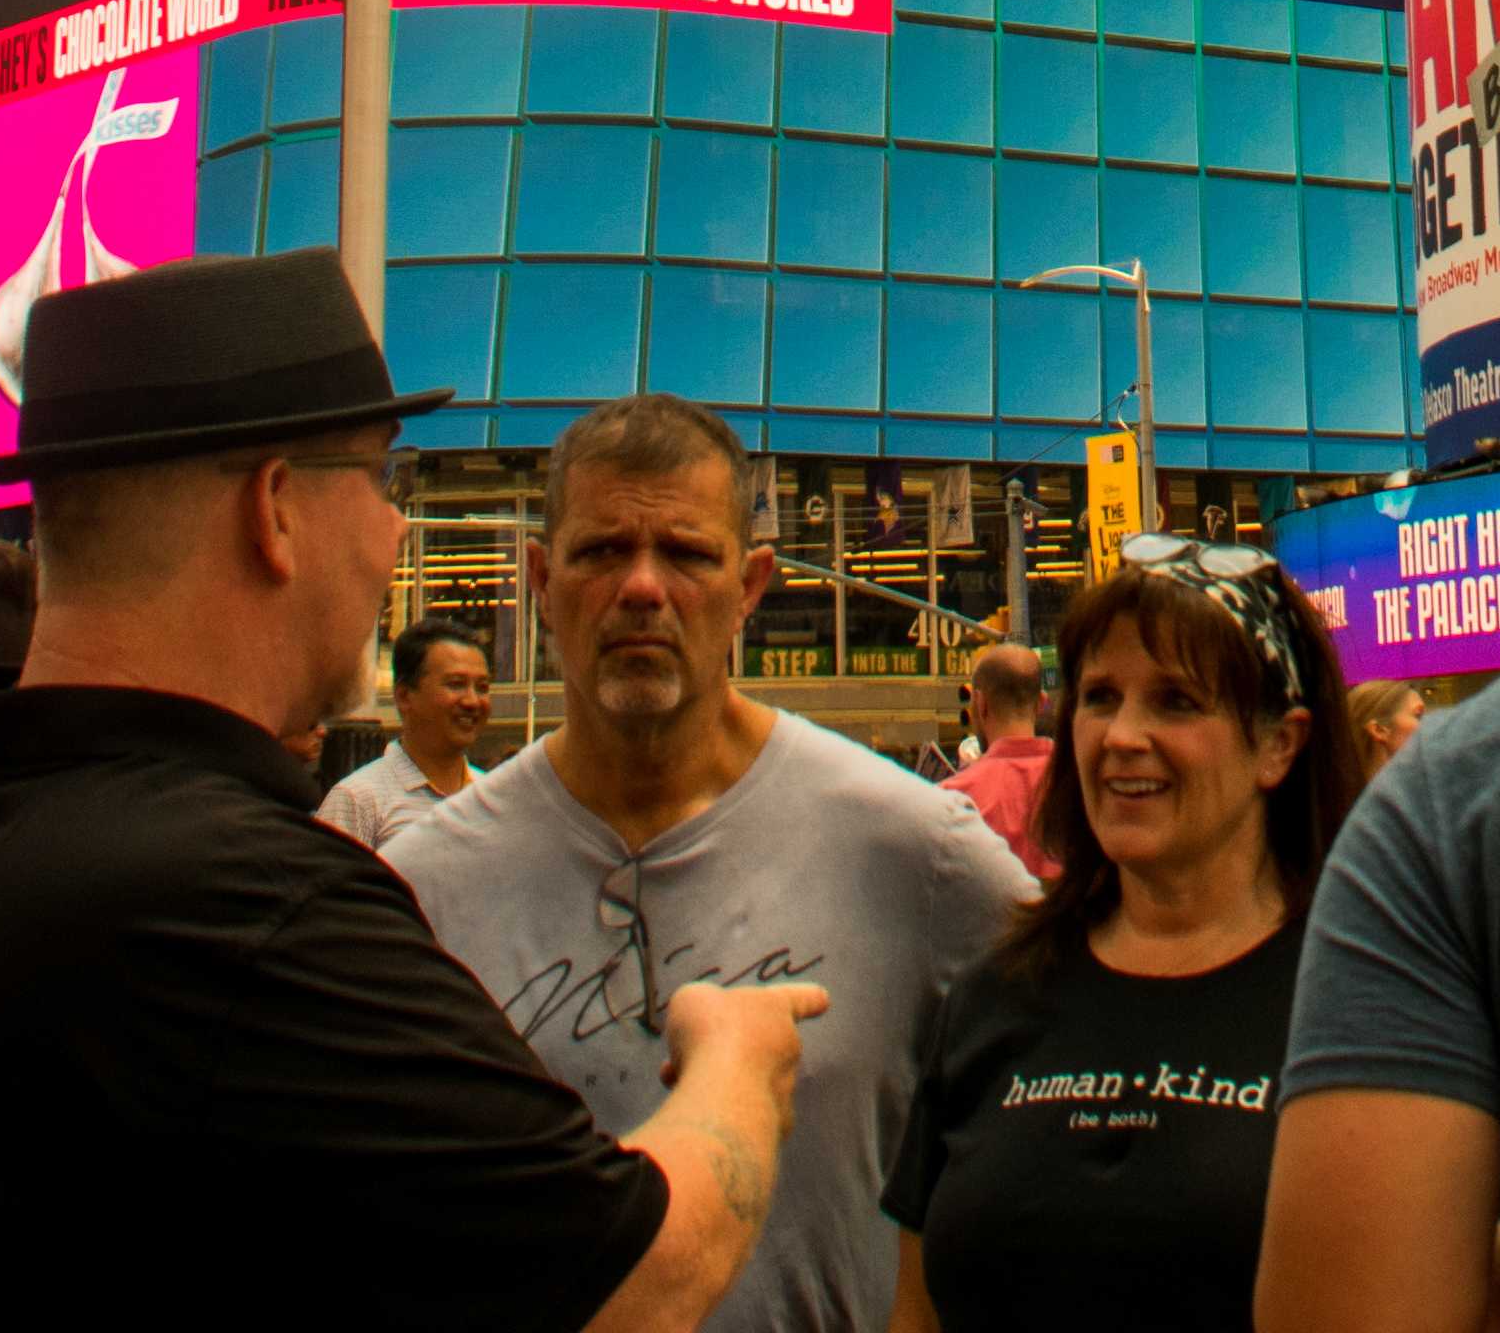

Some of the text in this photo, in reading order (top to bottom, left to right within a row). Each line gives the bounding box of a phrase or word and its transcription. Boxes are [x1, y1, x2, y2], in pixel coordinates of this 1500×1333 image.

[1427, 251, 1481, 304] Broadway
[1101, 501, 1125, 521] THE
[1398, 514, 1469, 578] RIGHT
[1372, 583, 1412, 645] THE
[762, 649, 819, 677] STEP
[852, 649, 973, 676] INTO THE GA
